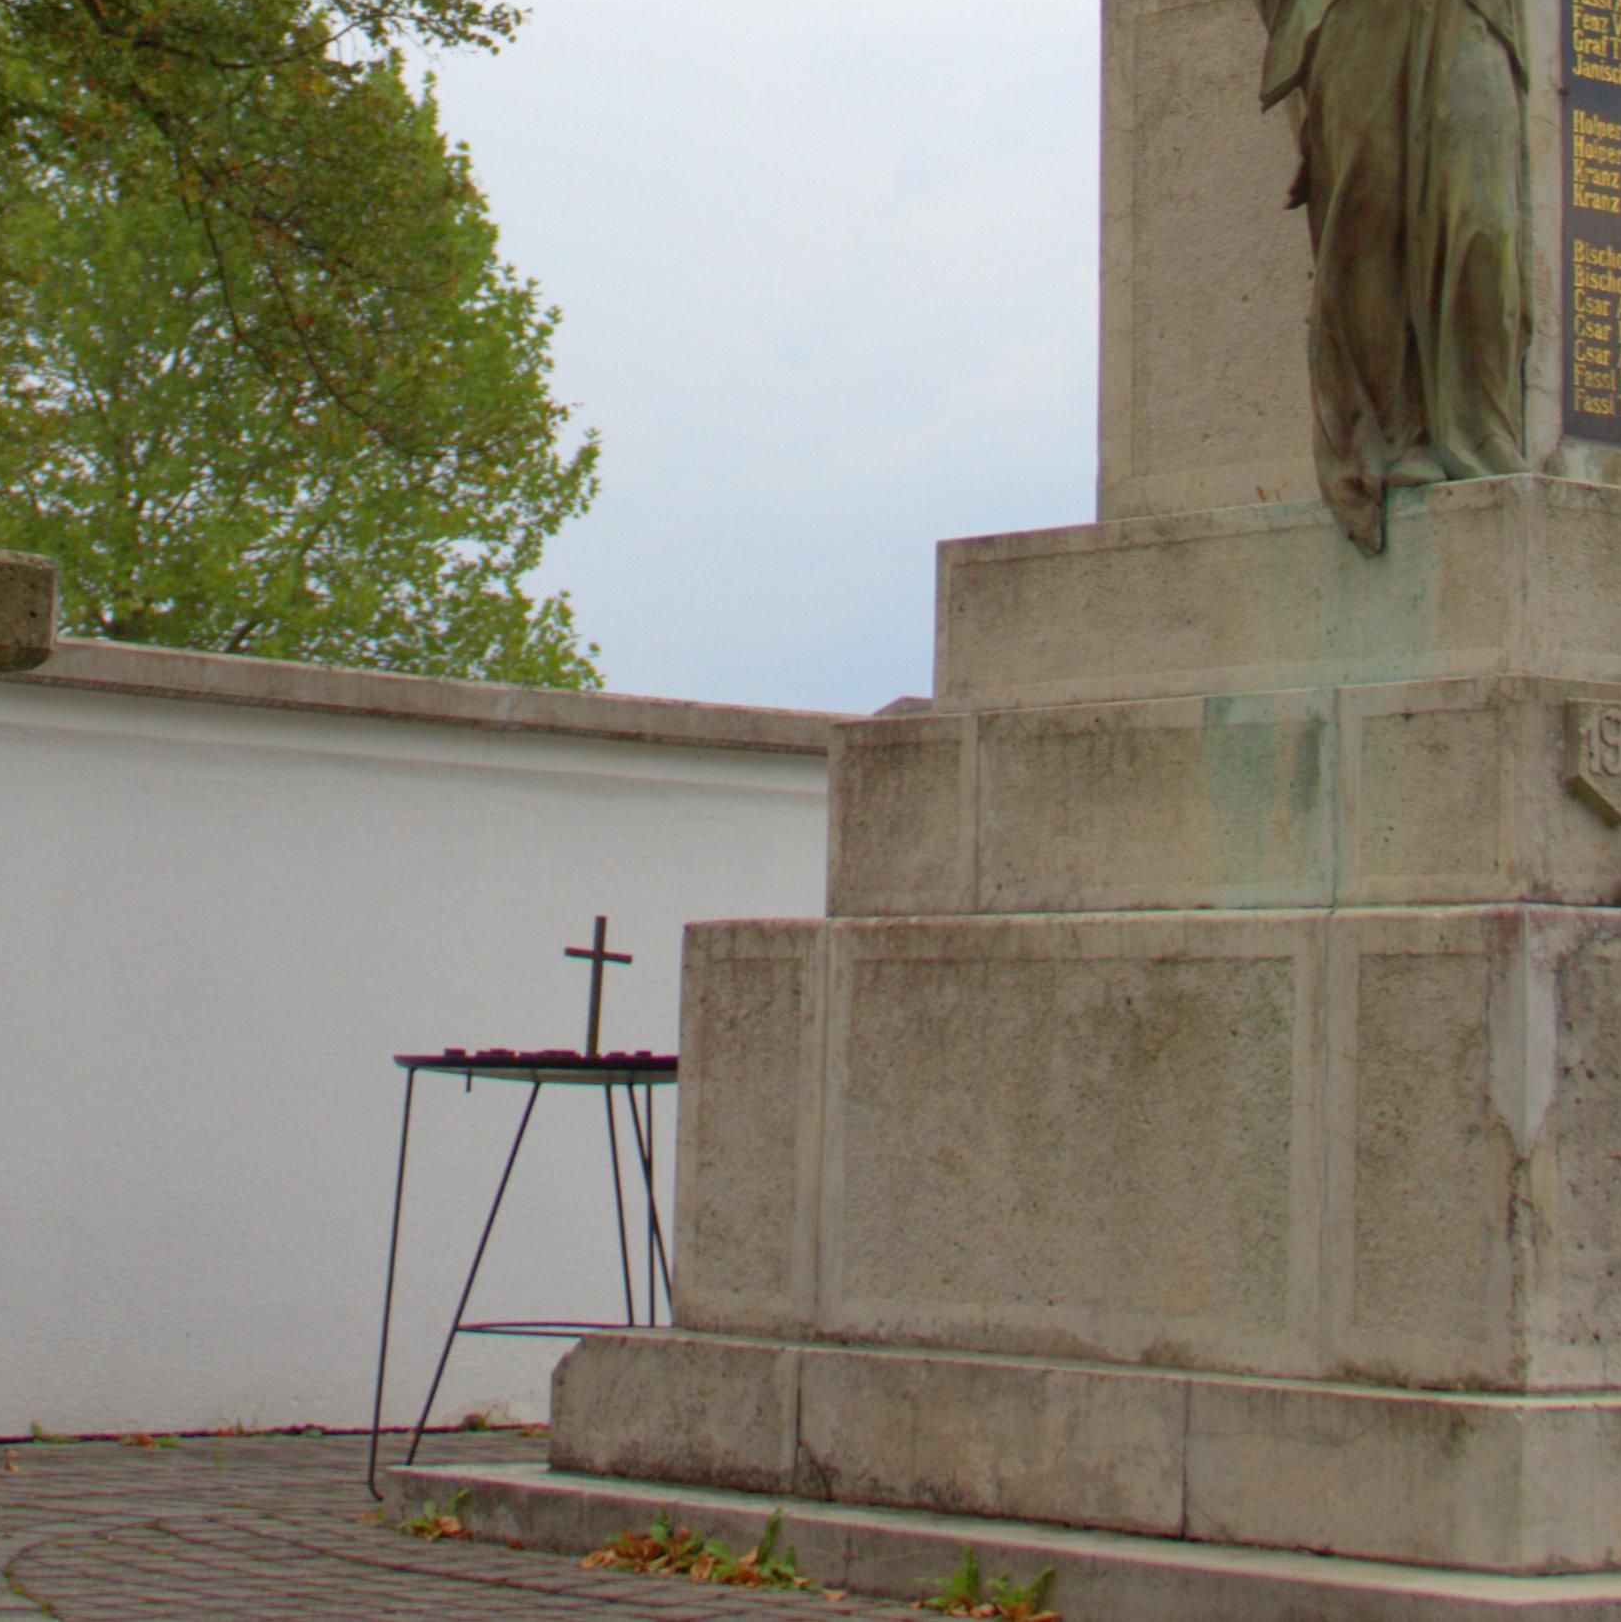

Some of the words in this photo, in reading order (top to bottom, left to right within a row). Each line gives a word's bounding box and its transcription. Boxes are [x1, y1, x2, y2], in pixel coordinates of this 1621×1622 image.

[1573, 29, 1609, 57] Graf
[1573, 159, 1621, 189] Kranz
[1573, 183, 1621, 214] Kranz
